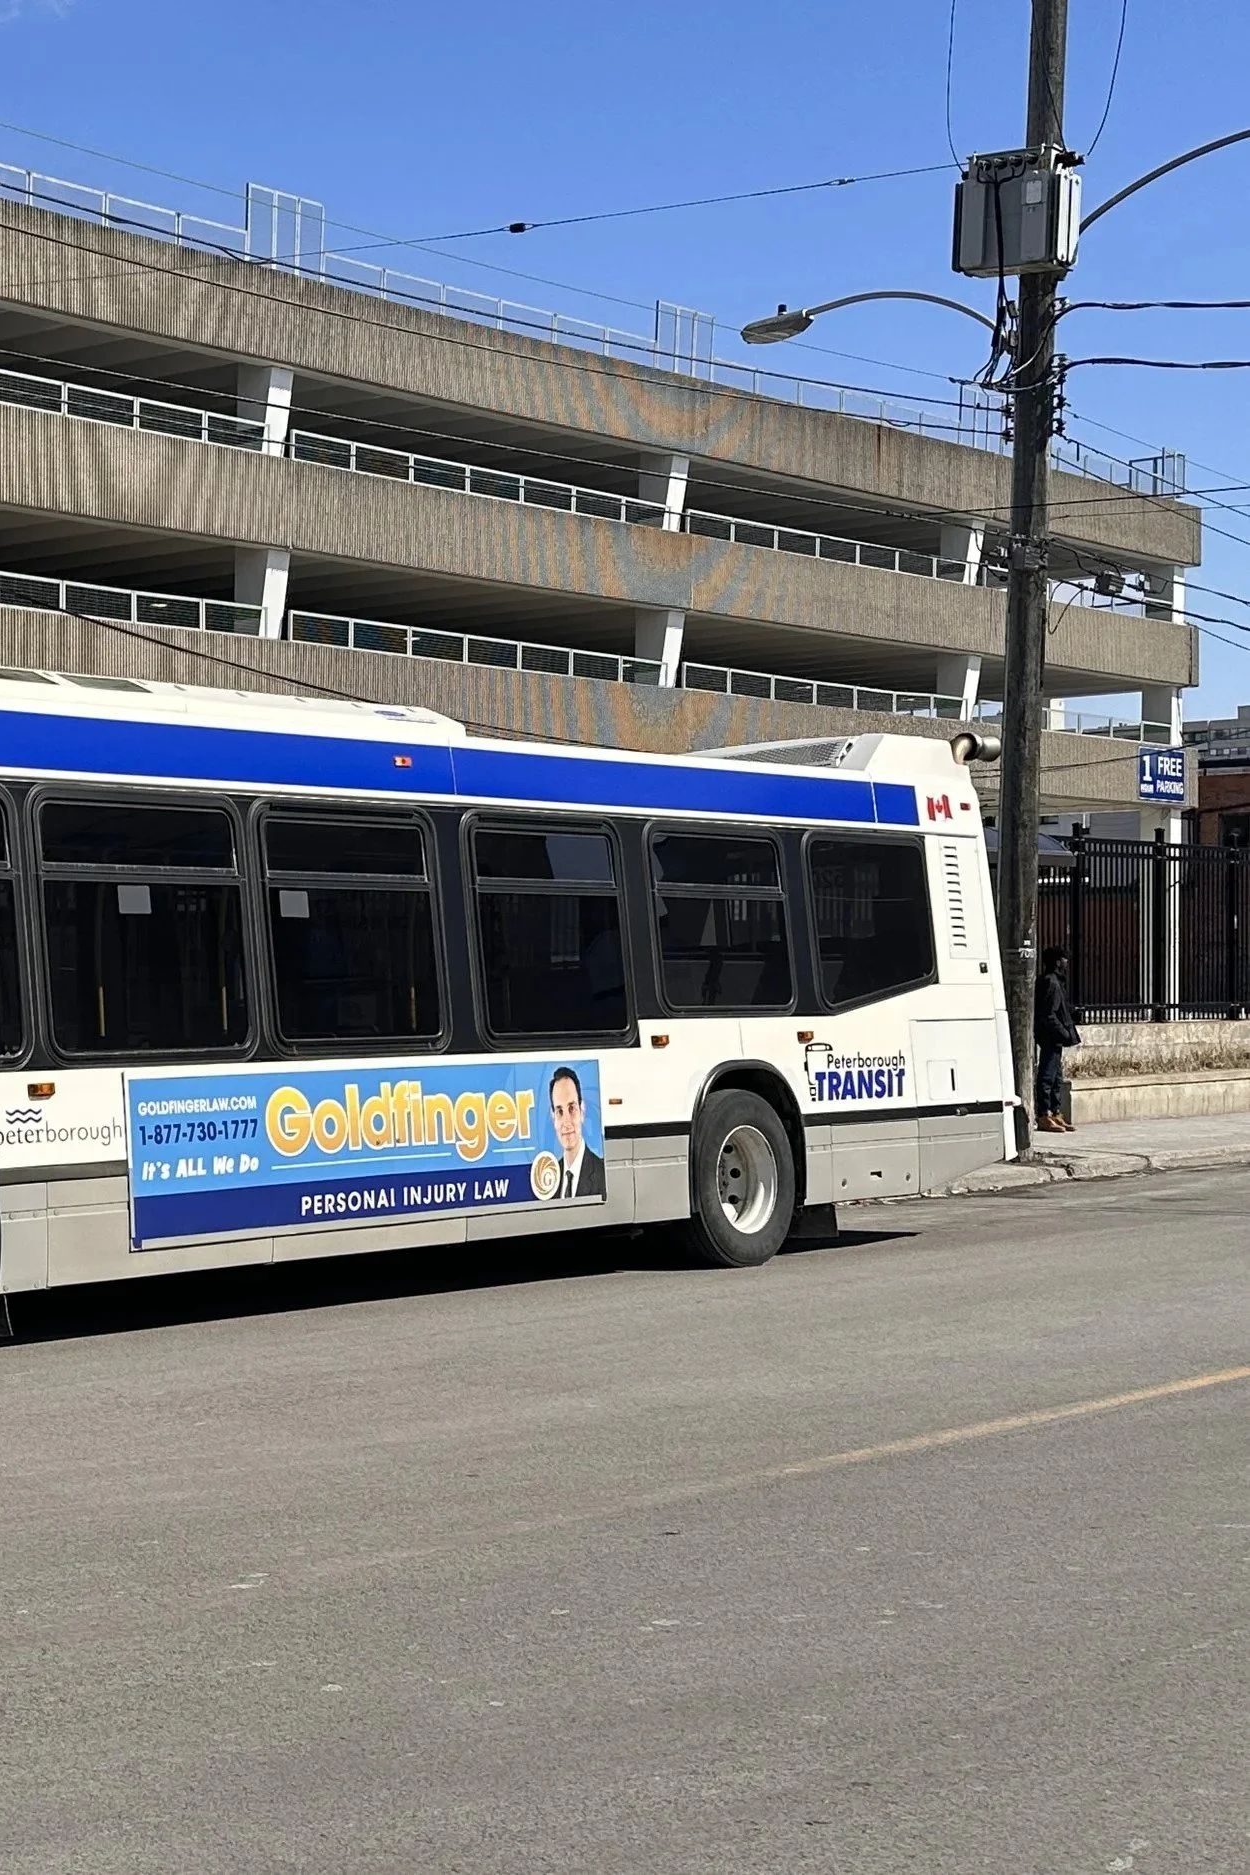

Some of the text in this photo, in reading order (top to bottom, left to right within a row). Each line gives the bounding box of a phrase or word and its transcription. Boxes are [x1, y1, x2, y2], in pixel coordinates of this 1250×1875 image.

[1143, 755, 1183, 781] 1 FREE
[1157, 780, 1184, 795] PARKING
[827, 1049, 905, 1071] Peterborough
[815, 1068, 905, 1101] TRANSIT
[138, 1080, 534, 1163] GOLDFINGERLAW.COM Goldfinger
[139, 1118, 258, 1146] 1-877-730-1777
[142, 1153, 259, 1181] It's ALL We Do
[403, 1182, 467, 1206] INJURY
[474, 1178, 509, 1200] LAW
